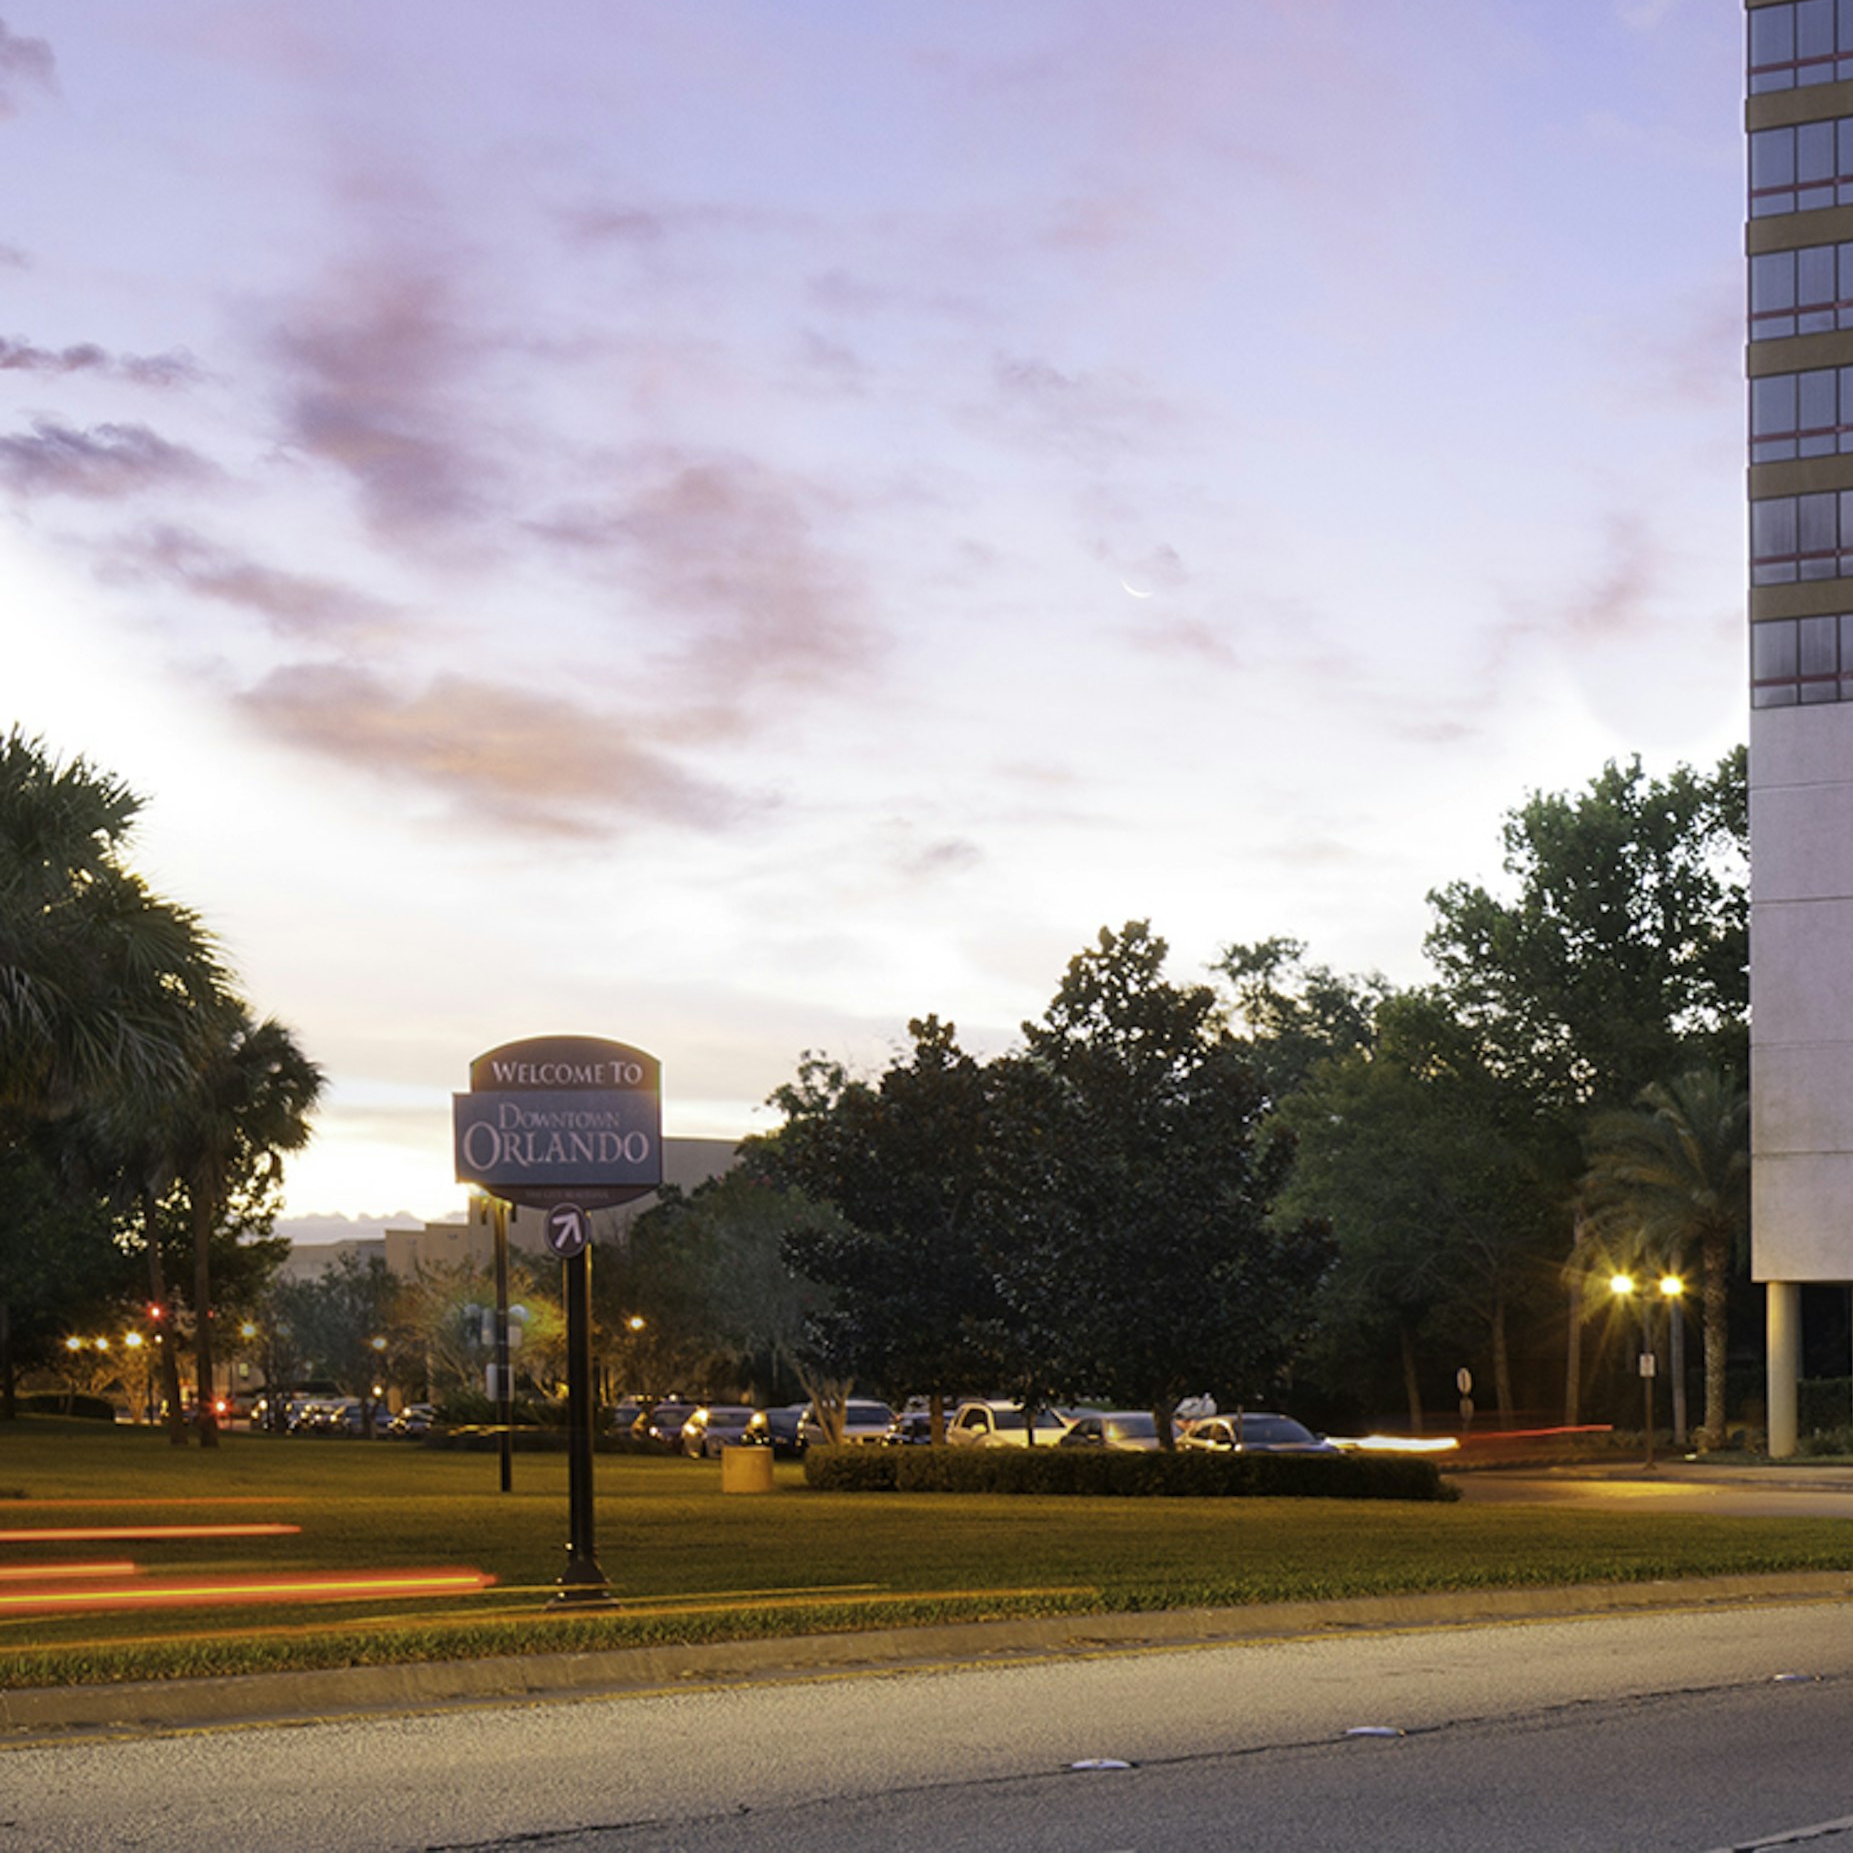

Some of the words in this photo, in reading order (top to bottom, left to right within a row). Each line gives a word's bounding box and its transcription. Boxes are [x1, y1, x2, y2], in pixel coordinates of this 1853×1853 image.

[492, 1061, 605, 1084] WELCOME
[609, 1061, 643, 1084] TO
[499, 1102, 620, 1130] DOWNTOWN
[463, 1121, 649, 1171] ORLANDO
